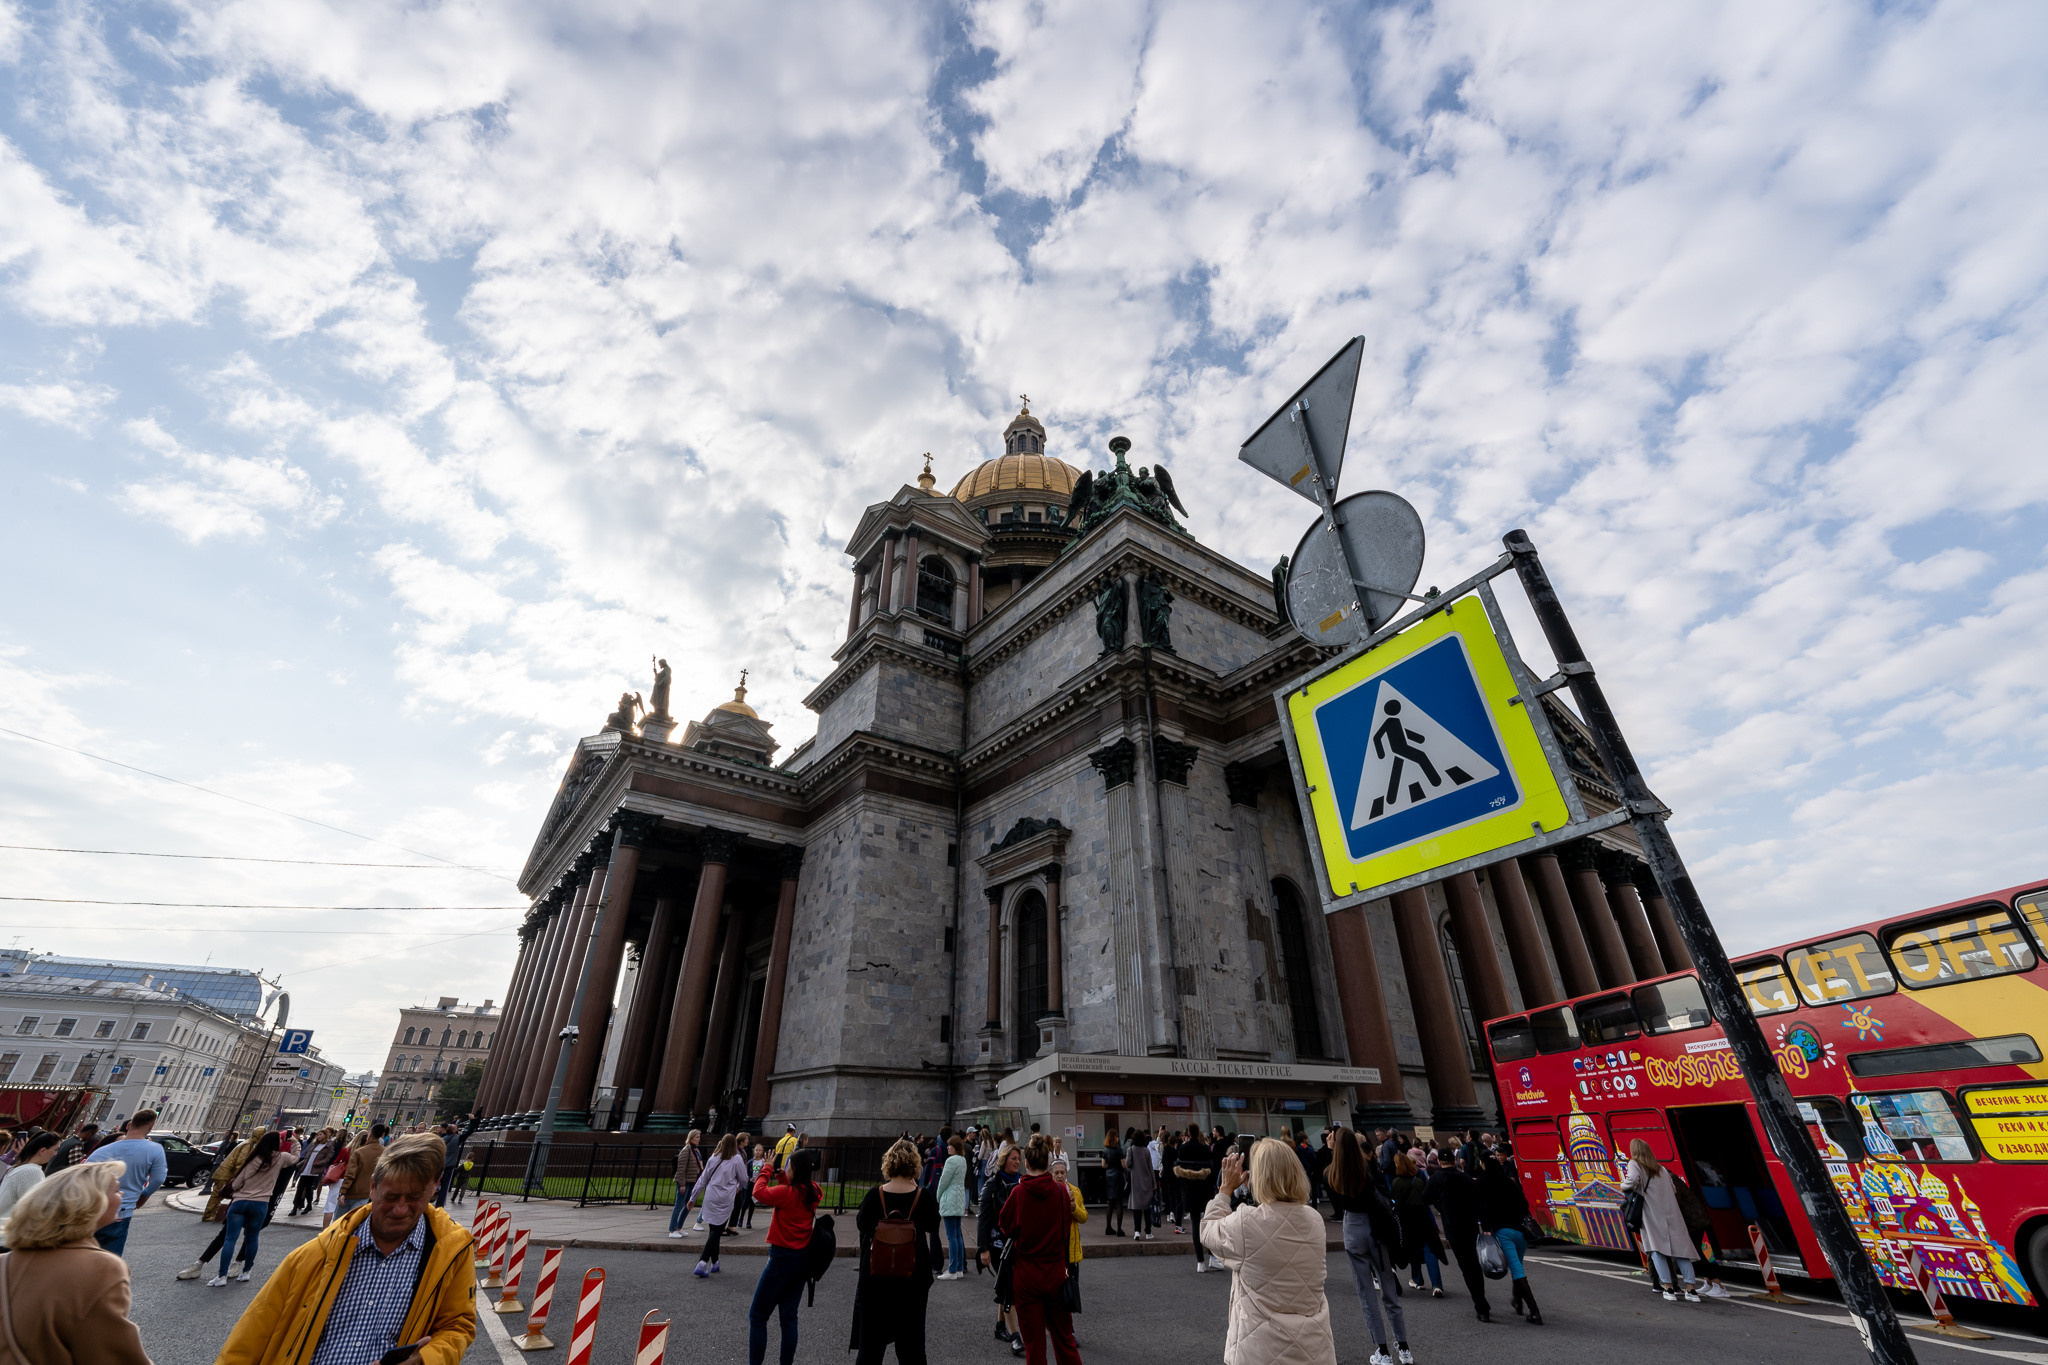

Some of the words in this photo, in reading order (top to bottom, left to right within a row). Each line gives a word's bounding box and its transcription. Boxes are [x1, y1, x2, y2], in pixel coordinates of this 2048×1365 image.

[287, 1032, 306, 1050] P
[1687, 1042, 1718, 1051] экскурсии
[1171, 1061, 1209, 1074] КАССЫ
[1216, 1063, 1254, 1075] TICKET
[1257, 1065, 1292, 1077] OFFICE
[1645, 1045, 1809, 1088] CitySightsng
[1975, 1096, 2021, 1106] ВЕЧЕРНИЕ
[1998, 1122, 2026, 1132] РЕКИ
[2027, 1122, 2036, 1131] И
[2037, 1122, 2048, 1131] К
[1998, 1143, 2048, 1155] РАЗВОДН
